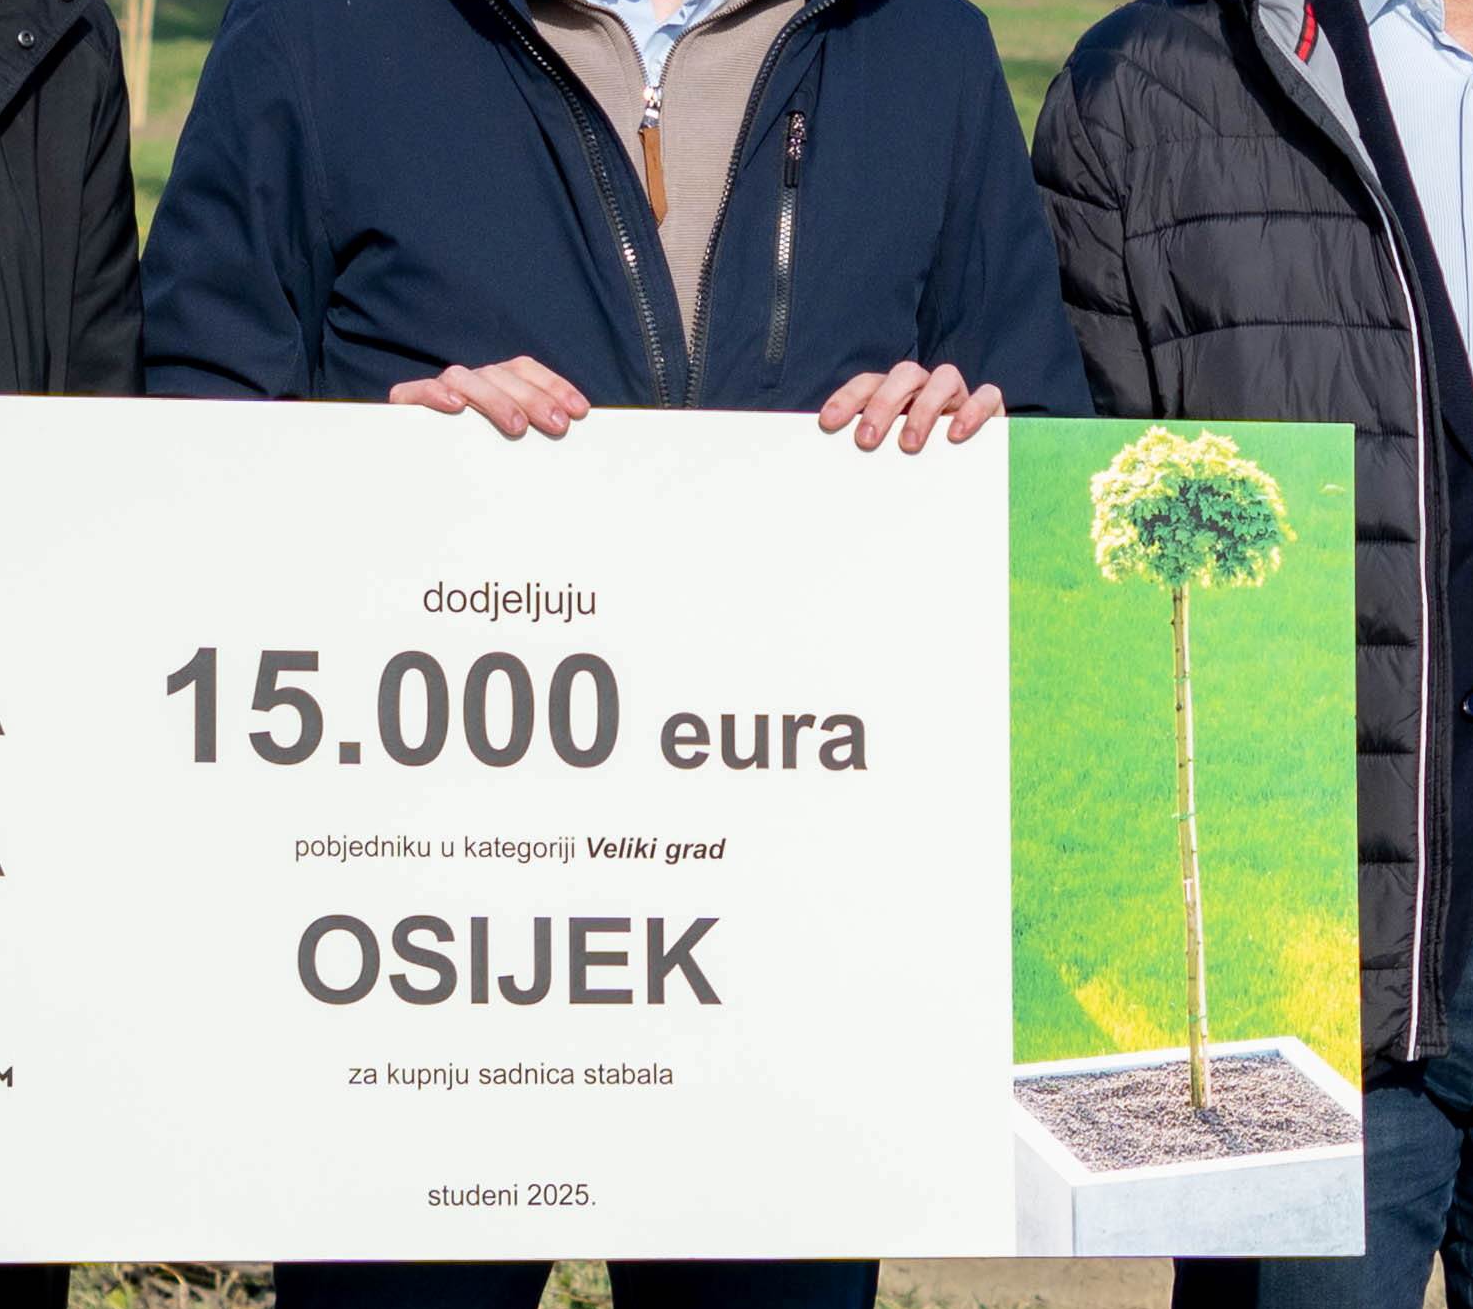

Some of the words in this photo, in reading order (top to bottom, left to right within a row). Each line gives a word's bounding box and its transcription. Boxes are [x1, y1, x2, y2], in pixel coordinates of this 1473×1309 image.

[422, 580, 597, 623] dodjeljuju
[165, 646, 620, 769] 15.000
[659, 711, 868, 772] eura
[294, 834, 432, 864] pobjedniku
[441, 841, 455, 858] u
[464, 835, 576, 865] kategoriji
[585, 836, 658, 860] Veliki
[664, 837, 727, 866] grad
[296, 913, 723, 1006] OSIJEK
[348, 1067, 378, 1085] za
[387, 1062, 470, 1091] kupnju
[478, 1062, 575, 1085] sadnica
[583, 1062, 674, 1085] stabala
[428, 1183, 518, 1207] studeni
[526, 1183, 597, 1207] 2025.
